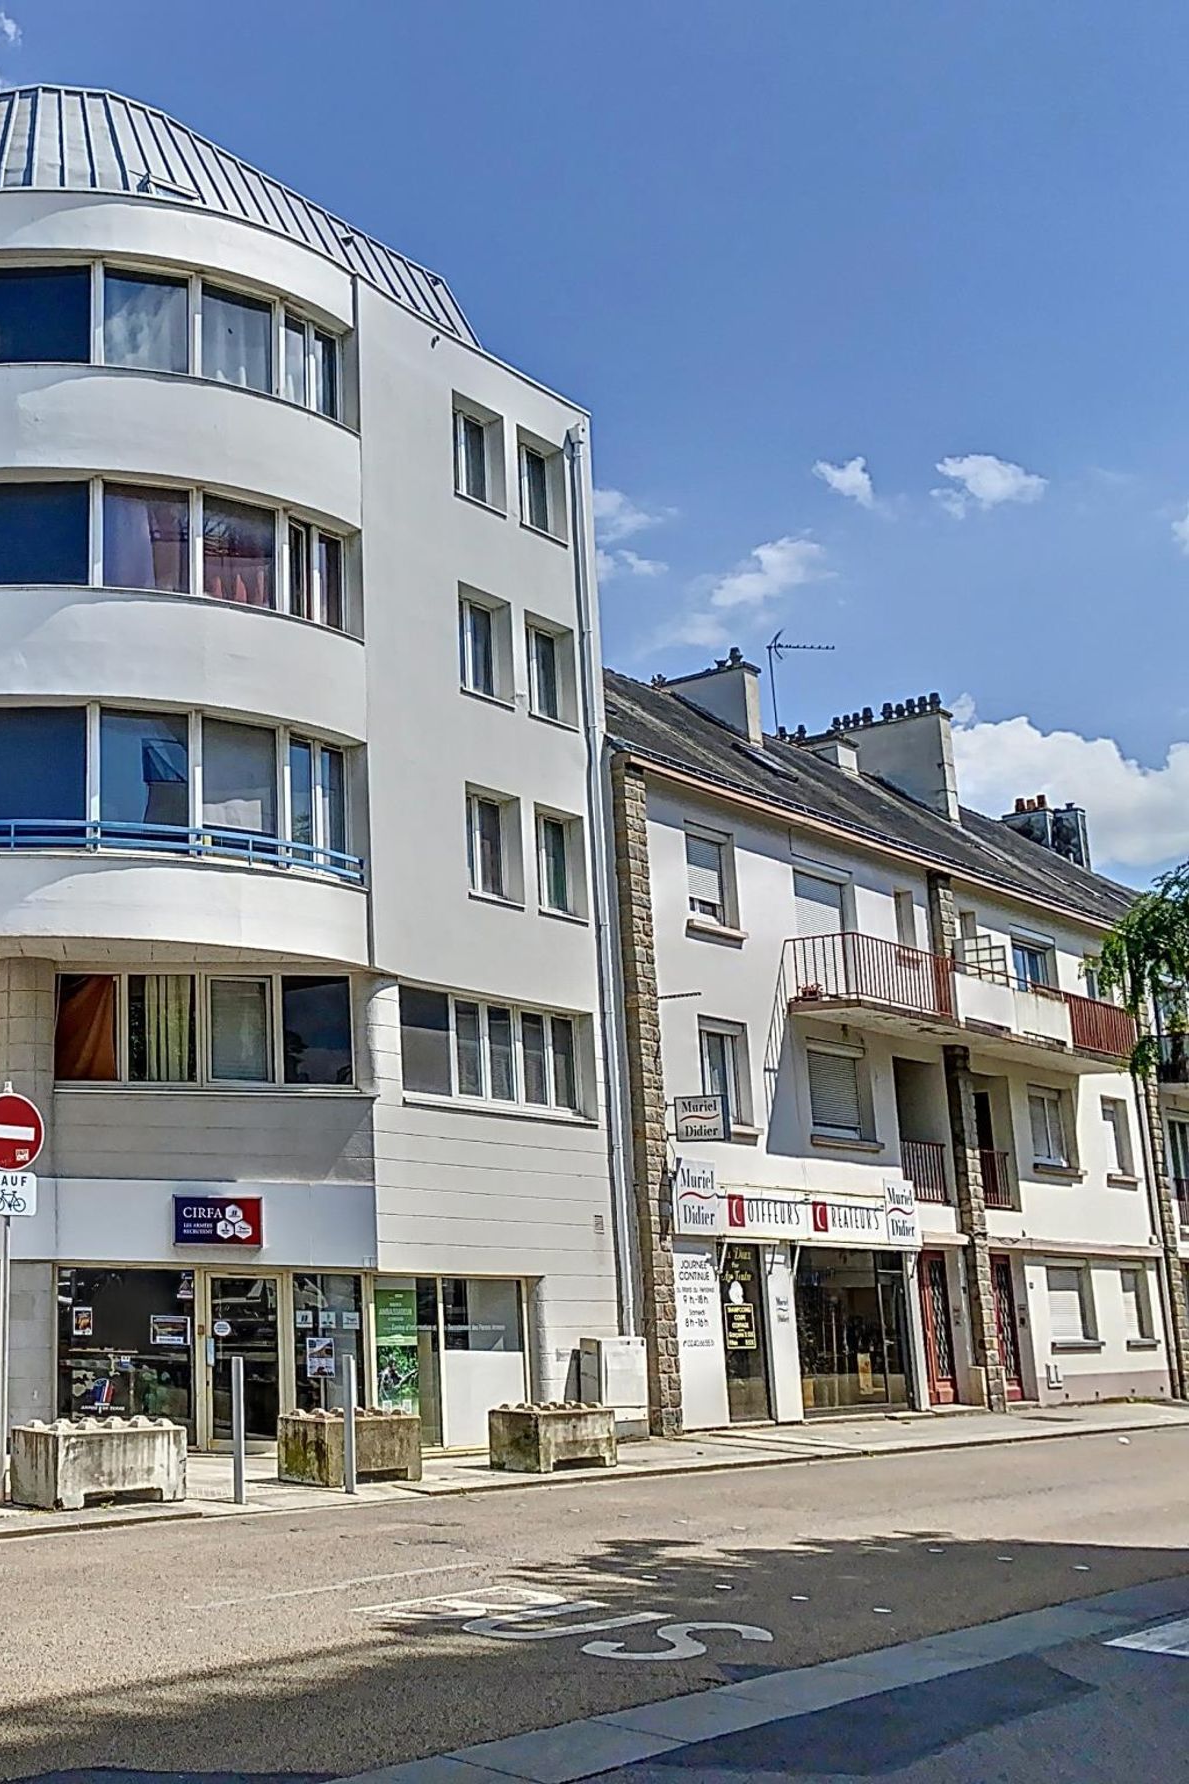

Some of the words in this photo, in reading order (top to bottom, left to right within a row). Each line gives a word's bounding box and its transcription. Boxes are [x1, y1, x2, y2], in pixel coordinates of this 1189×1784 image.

[681, 1100, 717, 1114] Muriel
[685, 1125, 719, 1137] Didier
[680, 1168, 714, 1190] Muriel
[887, 1187, 913, 1207] Muriel
[183, 1206, 223, 1219] CIRFA
[683, 1204, 716, 1226] Didier
[731, 1196, 801, 1225] COIFFEURS
[891, 1218, 915, 1237] Didier
[679, 1272, 710, 1281] CONTINUE
[349, 1585, 774, 1661] BUS
